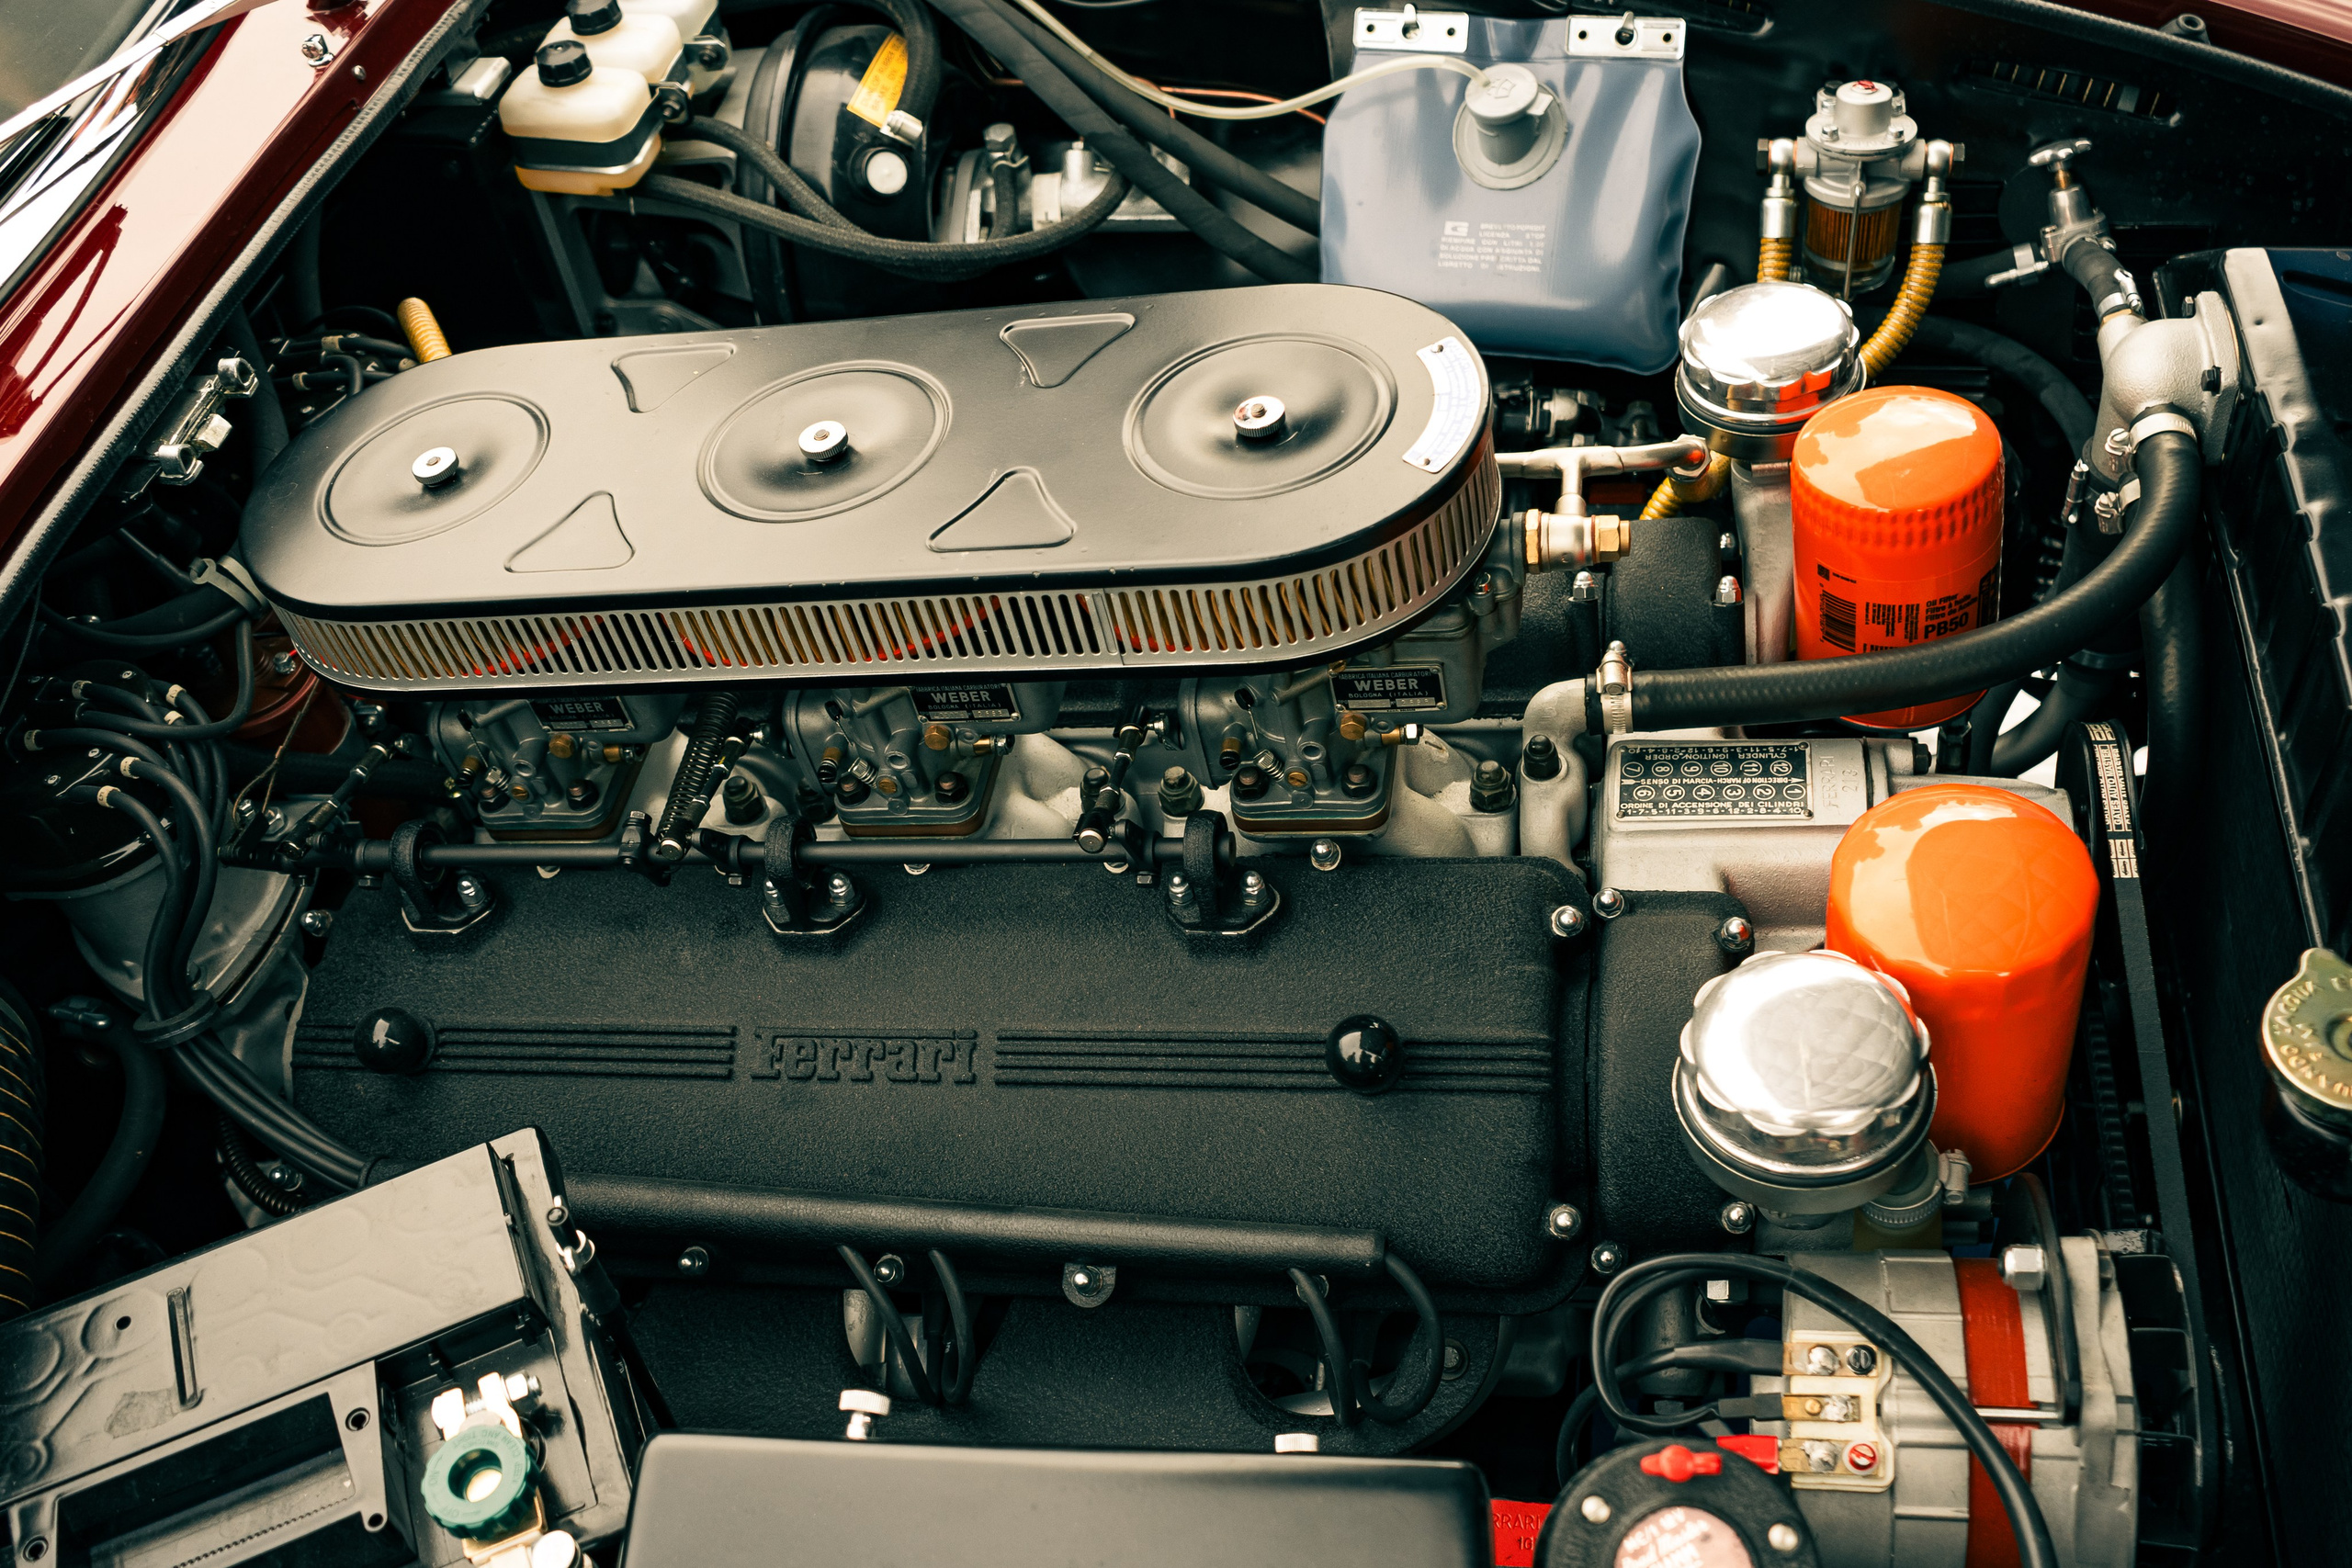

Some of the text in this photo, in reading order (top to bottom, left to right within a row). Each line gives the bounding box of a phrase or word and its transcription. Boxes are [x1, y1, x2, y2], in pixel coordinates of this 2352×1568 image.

[1450, 244, 1475, 253] ACQUA
[1939, 593, 1959, 604] Filter
[1924, 612, 1969, 639] PB50
[1353, 678, 1419, 692] WEBER
[931, 691, 991, 704] WEBER
[549, 702, 605, 714] WEBER
[1819, 754, 1838, 808] FERRARI
[2100, 748, 2122, 825] GATES AUTO MASTER
[751, 1025, 978, 1083] Ferrari
[2280, 1044, 2352, 1097] UANDO
[502, 1436, 521, 1457] CLEAN
[429, 1470, 439, 1484] ON
